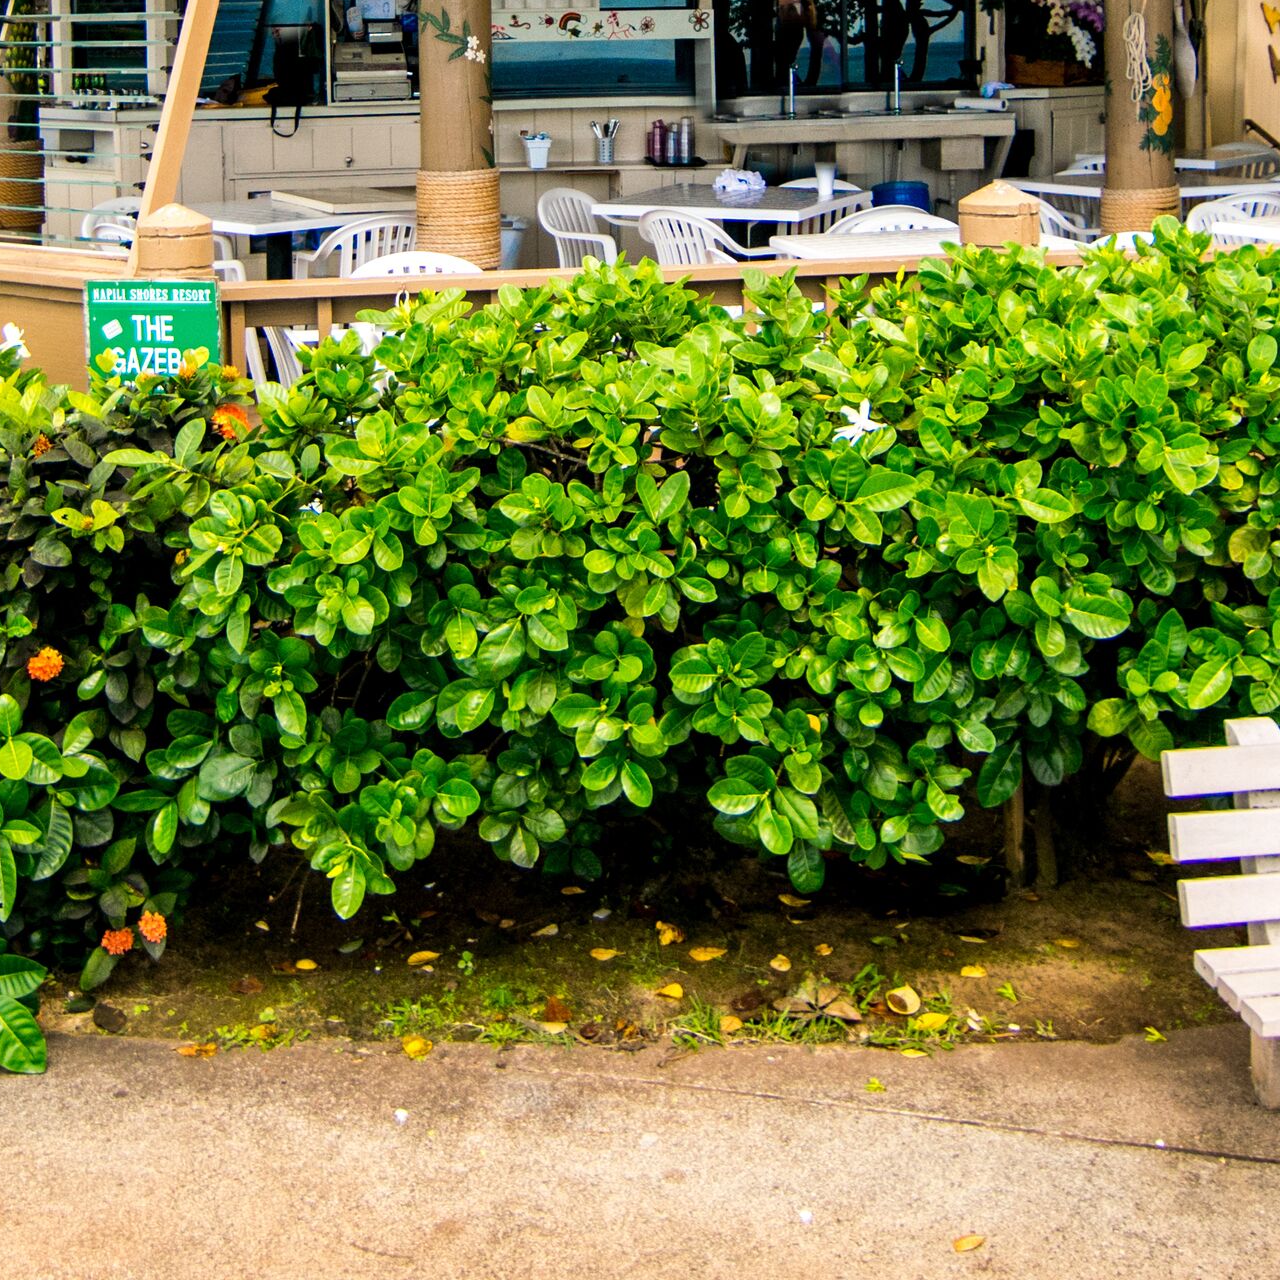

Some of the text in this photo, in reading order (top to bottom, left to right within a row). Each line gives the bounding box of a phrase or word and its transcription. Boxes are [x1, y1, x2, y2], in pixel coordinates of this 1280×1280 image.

[93, 288, 211, 301] NAPILI SHORES RESORT
[131, 314, 174, 342] THE
[111, 347, 192, 374] GAZEB
